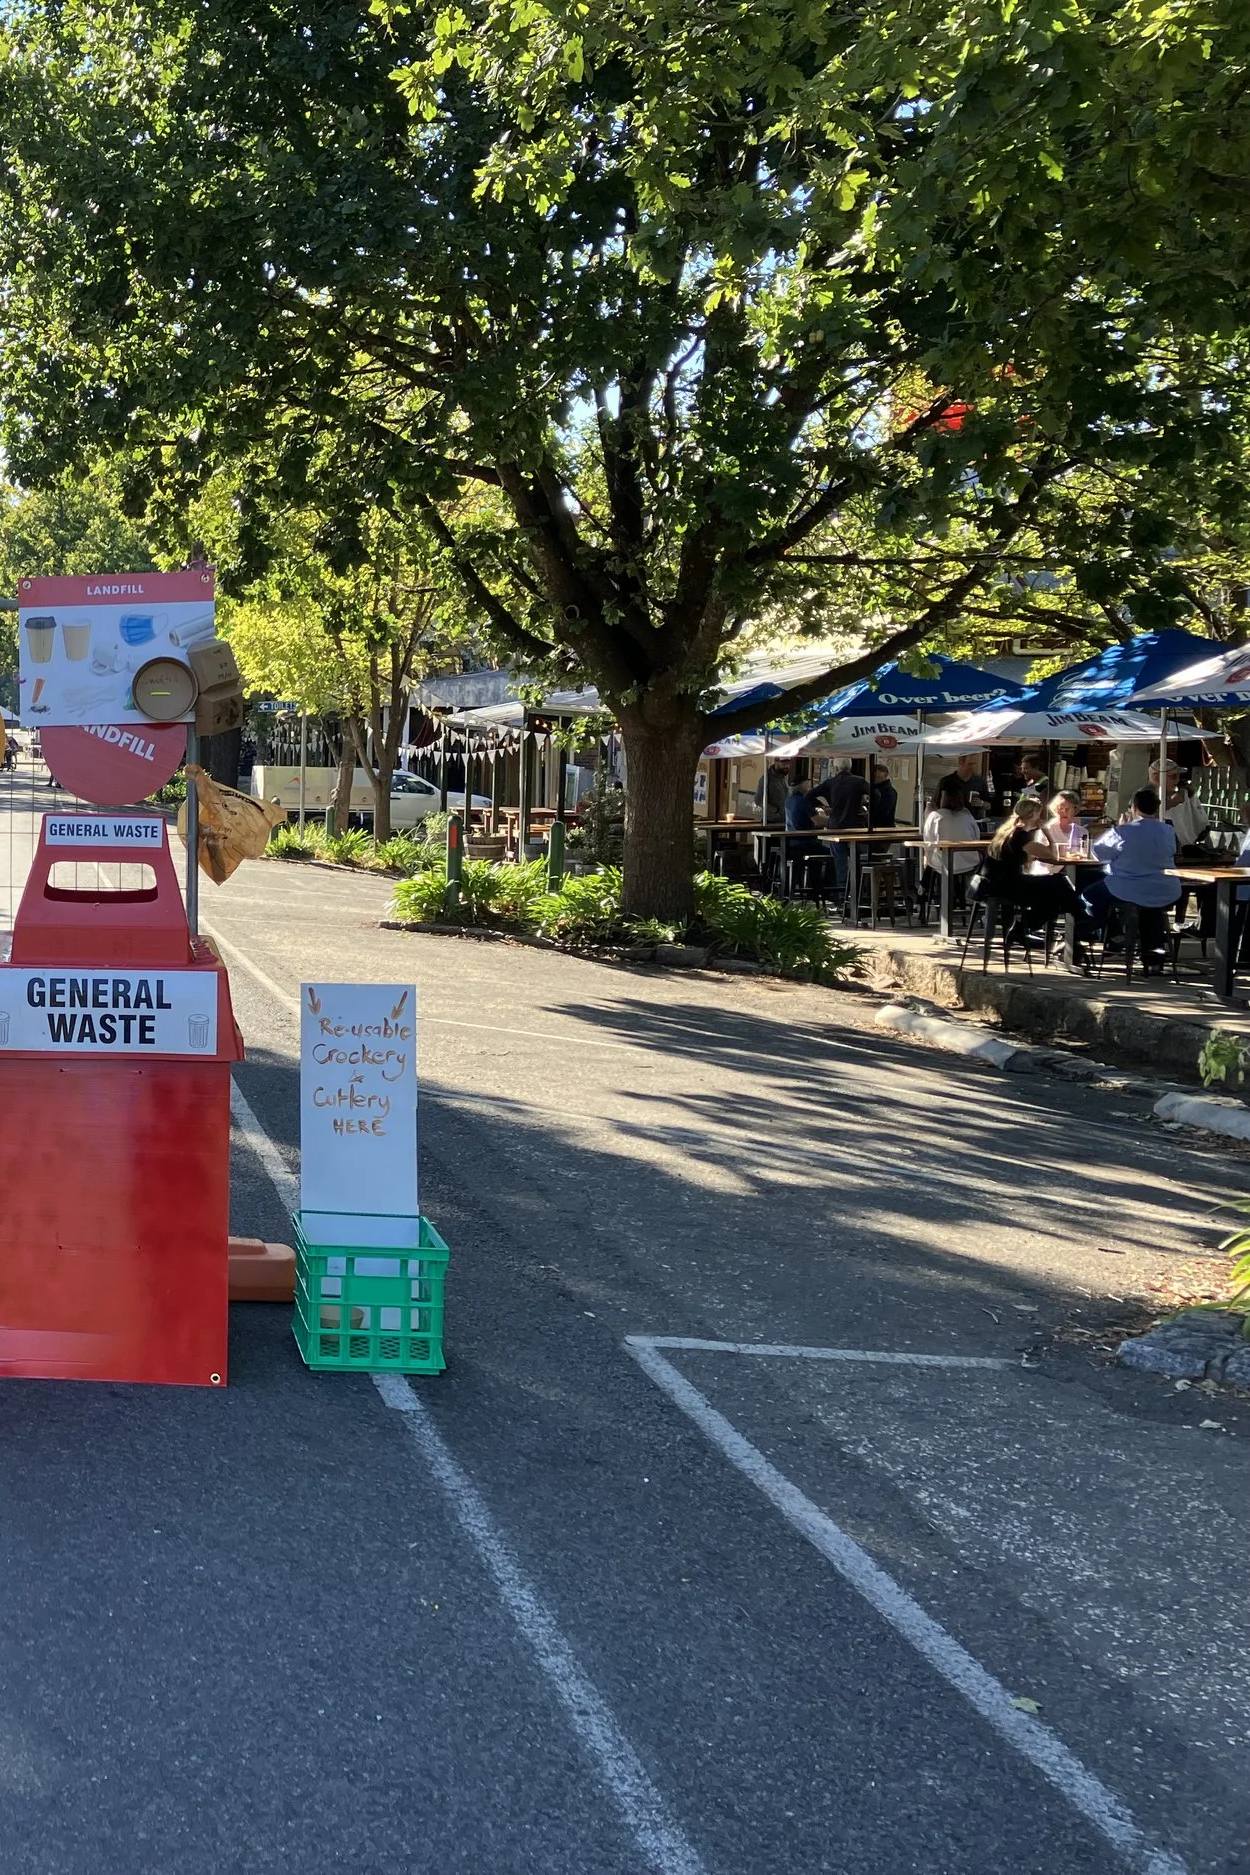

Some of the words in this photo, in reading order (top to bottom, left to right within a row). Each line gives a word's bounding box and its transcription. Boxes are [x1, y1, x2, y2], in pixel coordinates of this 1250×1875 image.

[86, 584, 144, 595] LANDFILL
[878, 693, 938, 705] Over
[941, 688, 1007, 703] beer?
[1046, 713, 1074, 727] JIM
[1072, 711, 1130, 726] BEAM
[851, 725, 876, 738] JIM
[876, 723, 918, 736] BEAM
[49, 823, 108, 837] GENERAL
[113, 824, 158, 838] WASTE
[27, 977, 172, 1010] GENERAL
[47, 1013, 156, 1045] WASTE
[312, 1043, 407, 1082] Crockery
[313, 1083, 391, 1119] Cutlery
[333, 1118, 387, 1137] HERE
